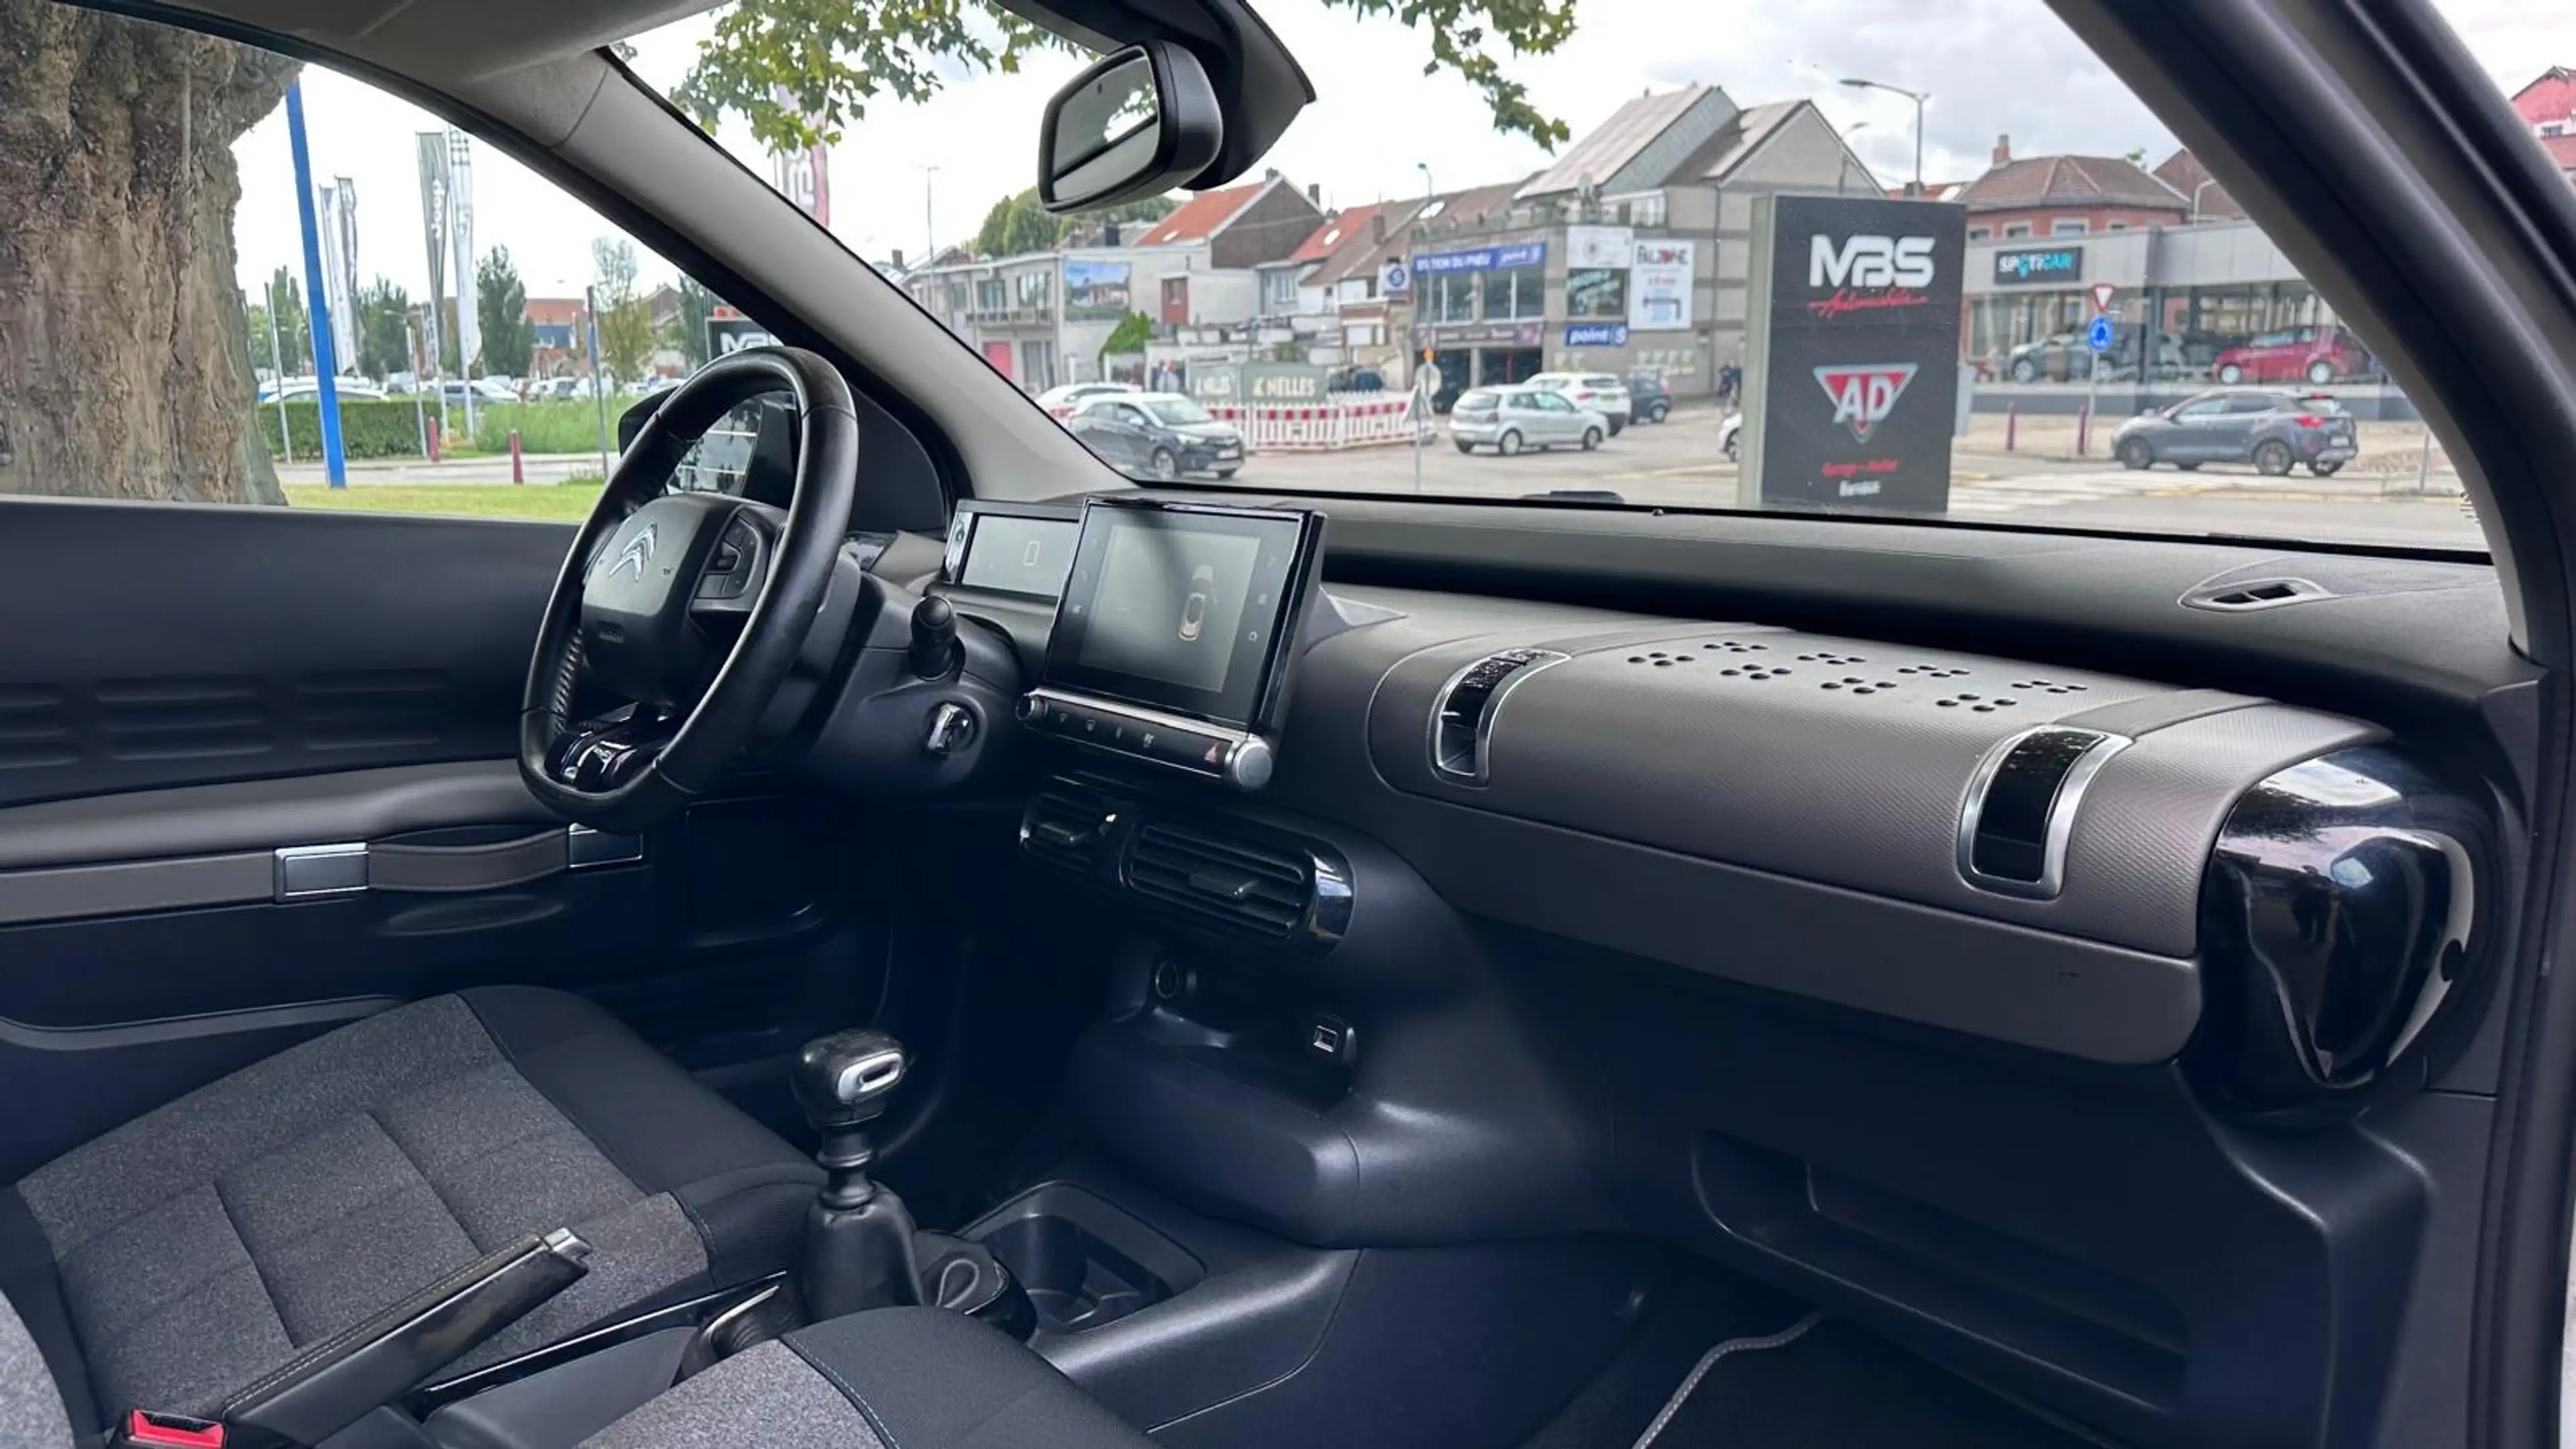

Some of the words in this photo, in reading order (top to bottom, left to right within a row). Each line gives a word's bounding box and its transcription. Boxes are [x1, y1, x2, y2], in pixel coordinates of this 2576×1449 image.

[1809, 234, 1936, 287] MBS
[1569, 327, 1609, 346] point
[1833, 375, 1896, 423] AD
